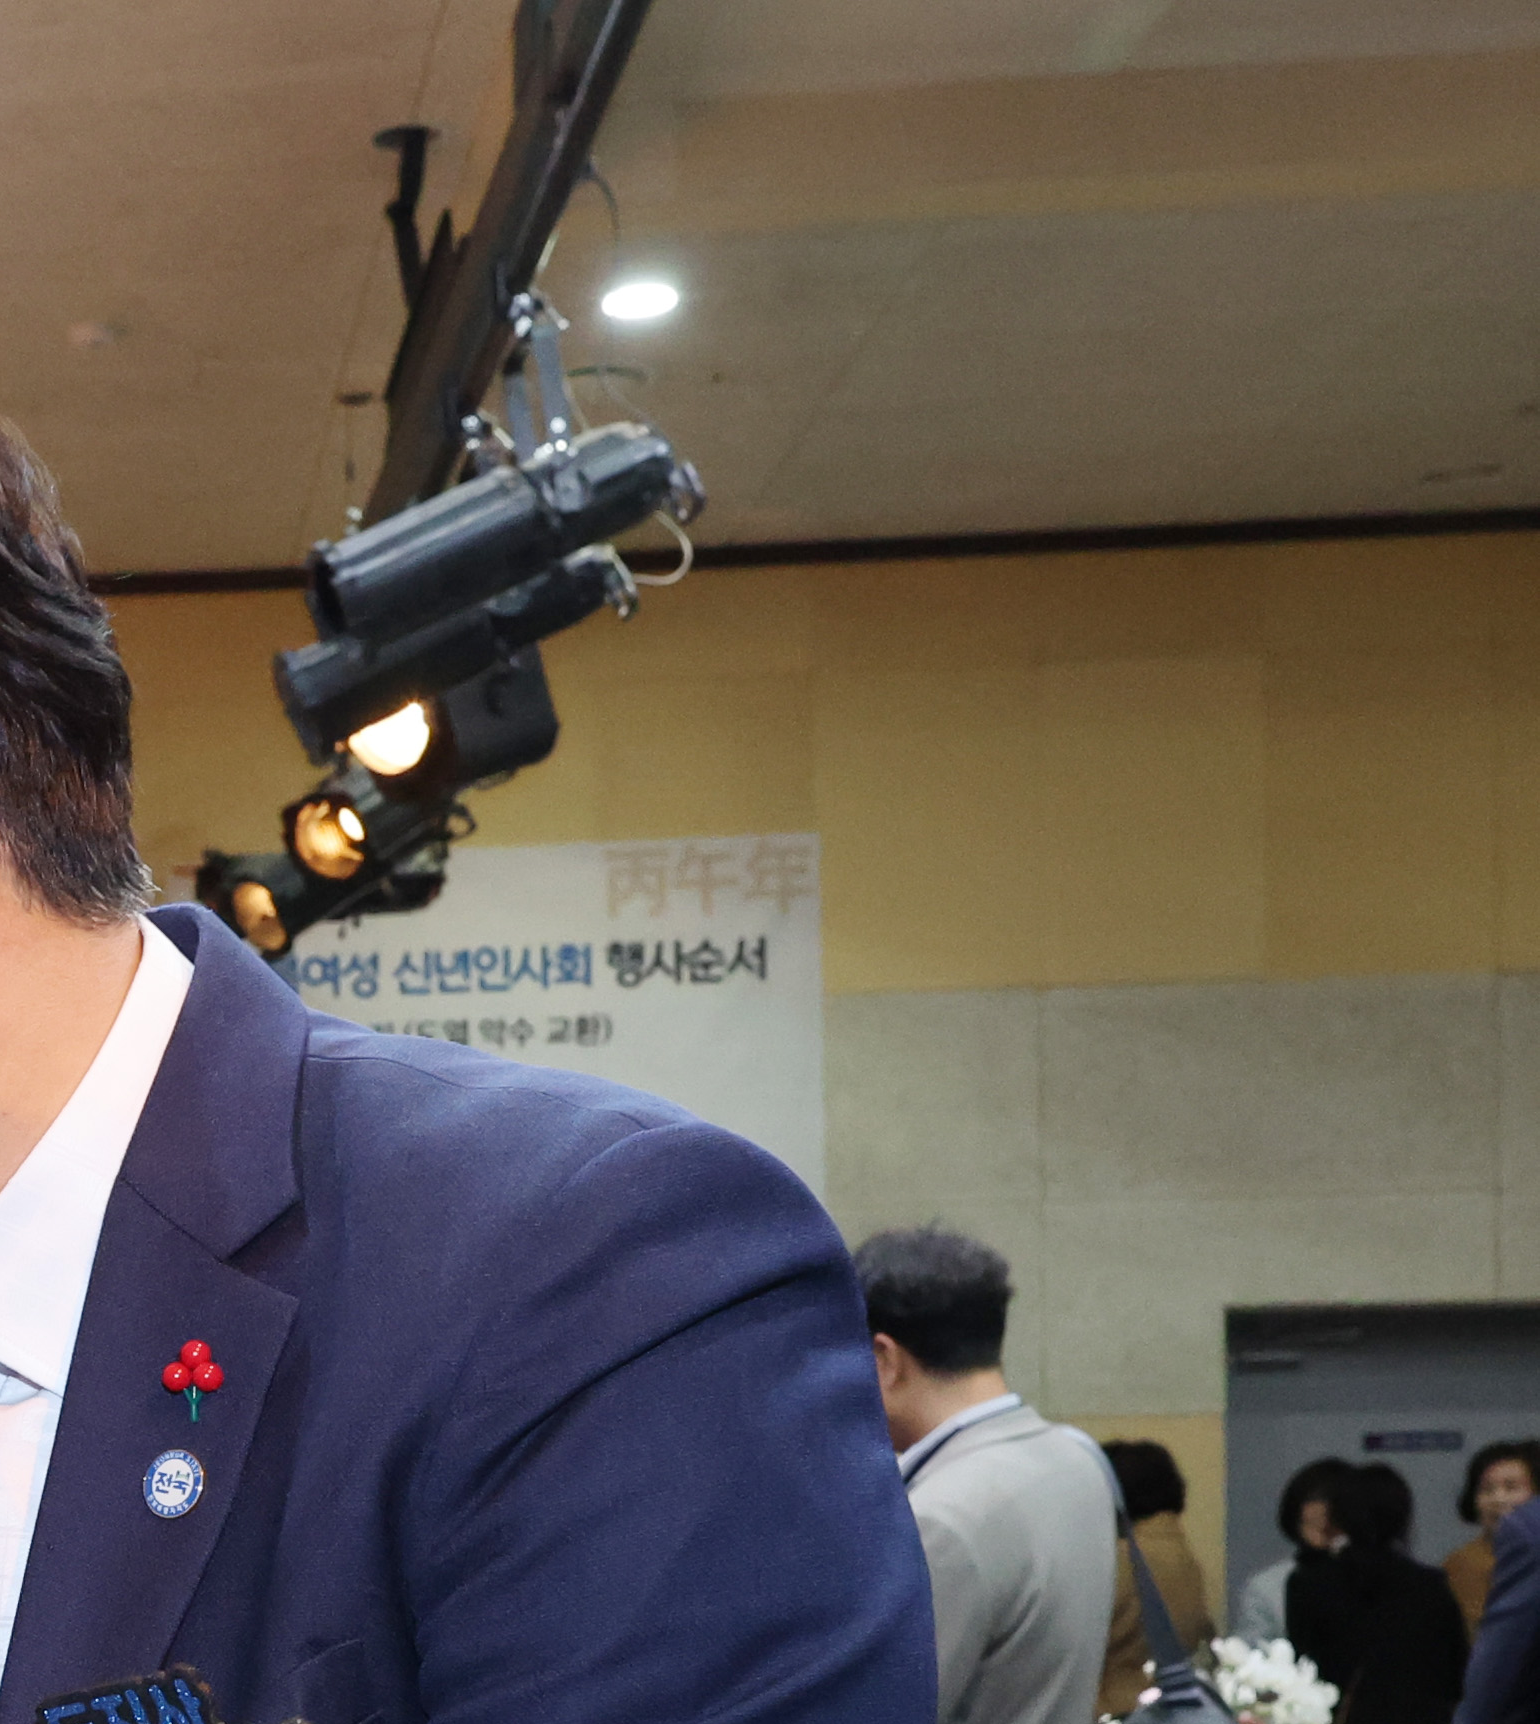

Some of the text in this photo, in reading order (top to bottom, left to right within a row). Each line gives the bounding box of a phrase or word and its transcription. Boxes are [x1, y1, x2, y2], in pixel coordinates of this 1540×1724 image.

[603, 838, 813, 917] 丙午年
[394, 942, 592, 995] 신년인사회
[606, 936, 766, 988] 행사순서
[155, 1470, 191, 1496] 전북
